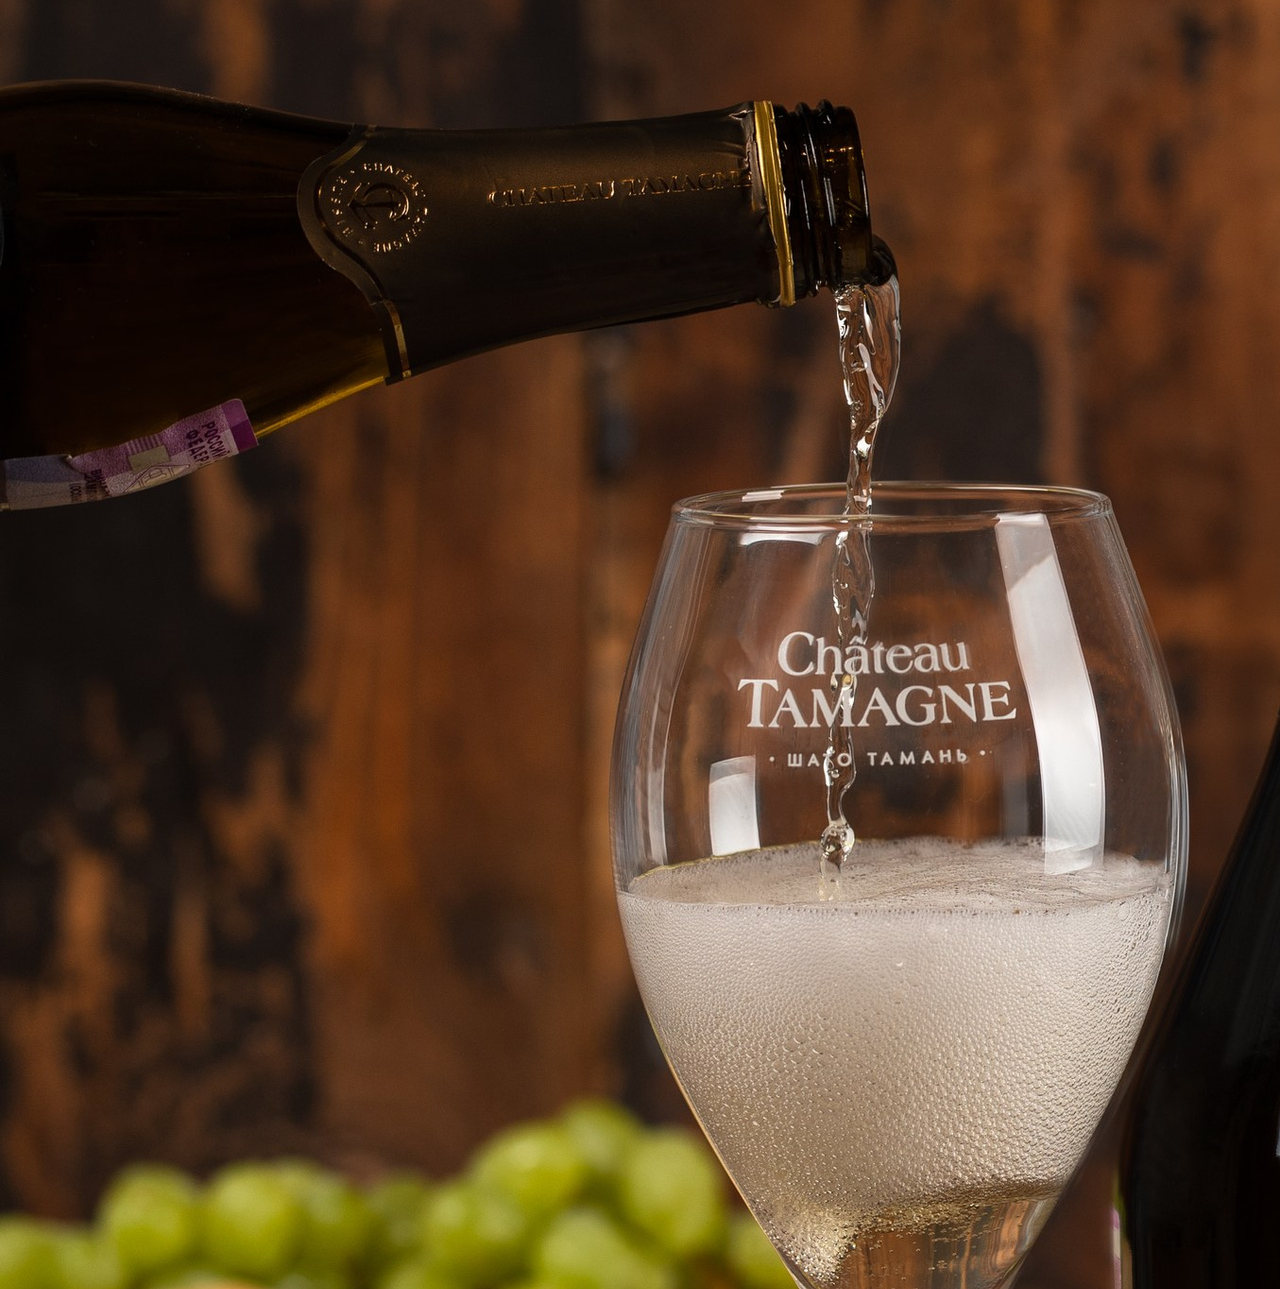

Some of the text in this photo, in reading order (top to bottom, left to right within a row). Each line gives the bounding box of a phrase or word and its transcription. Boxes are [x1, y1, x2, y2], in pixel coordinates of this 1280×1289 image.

[488, 179, 615, 207] CHATEAU
[186, 430, 211, 467] ФЕДЕР
[778, 631, 971, 676] Château
[737, 678, 1017, 728] TAMAGNE
[867, 749, 968, 766] ТАМАНЬ
